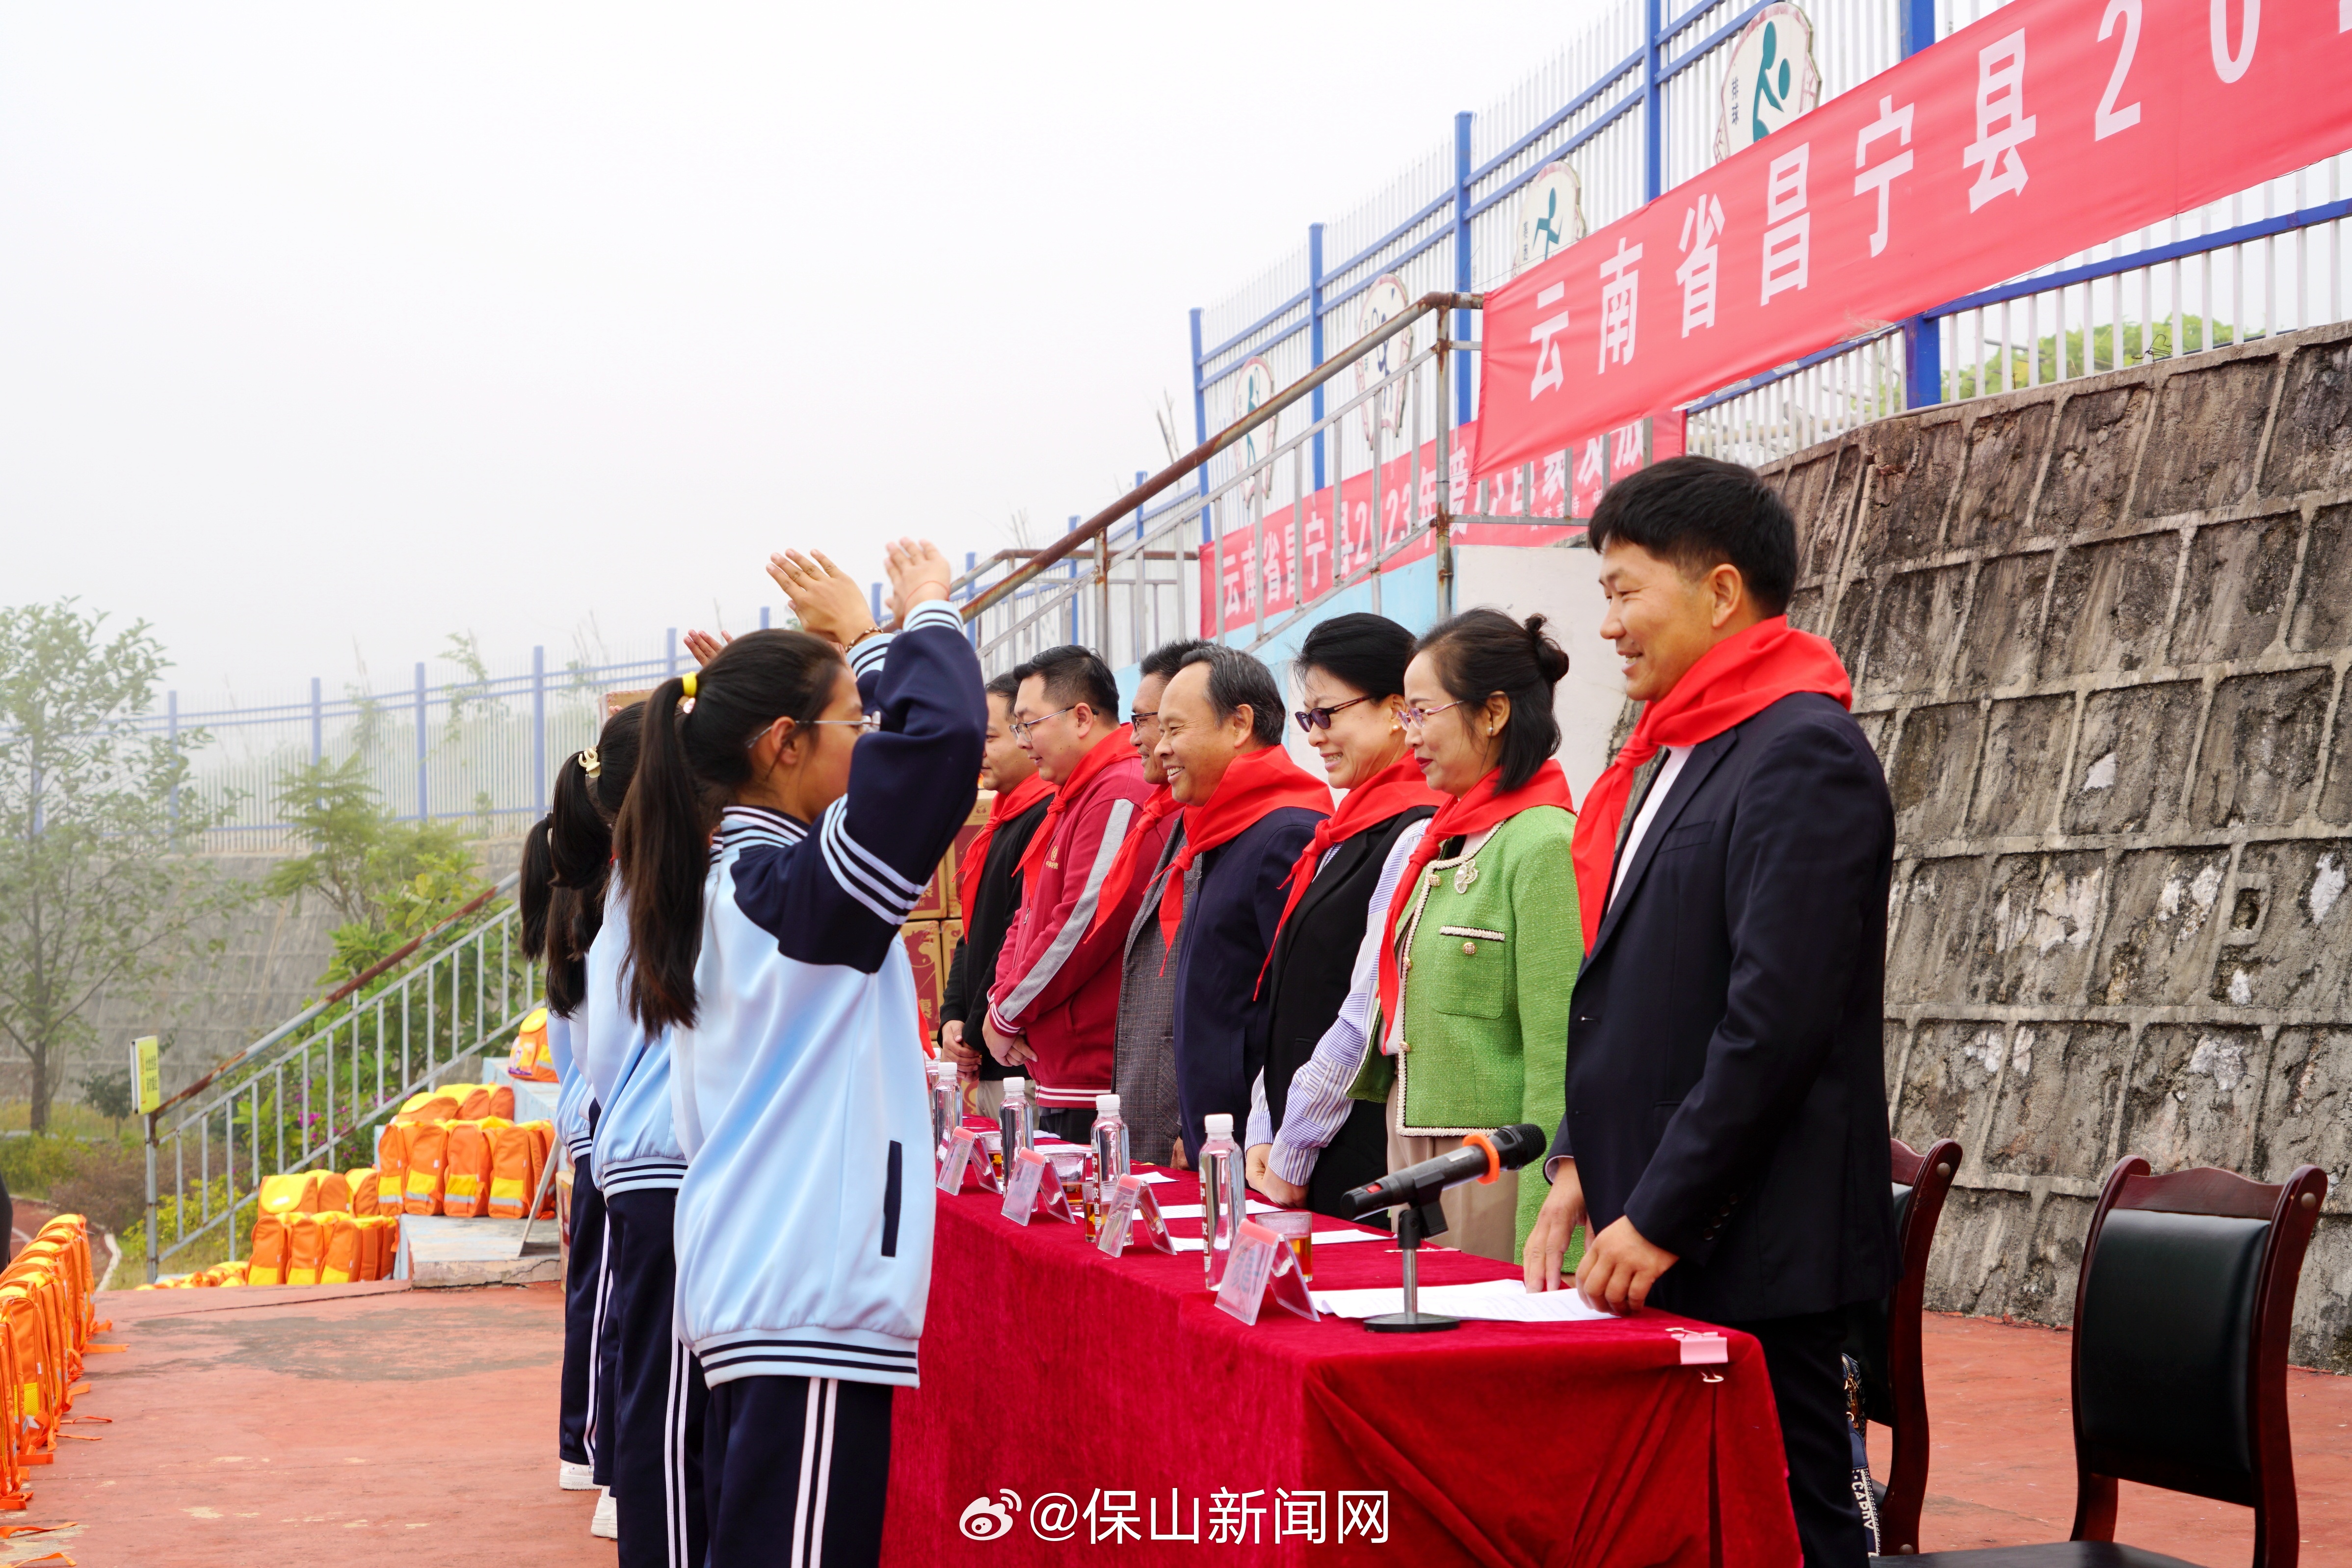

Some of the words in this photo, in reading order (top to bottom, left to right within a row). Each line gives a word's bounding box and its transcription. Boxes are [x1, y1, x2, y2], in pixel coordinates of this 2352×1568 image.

[1530, 0, 2352, 401] 云南省昌宁县20
